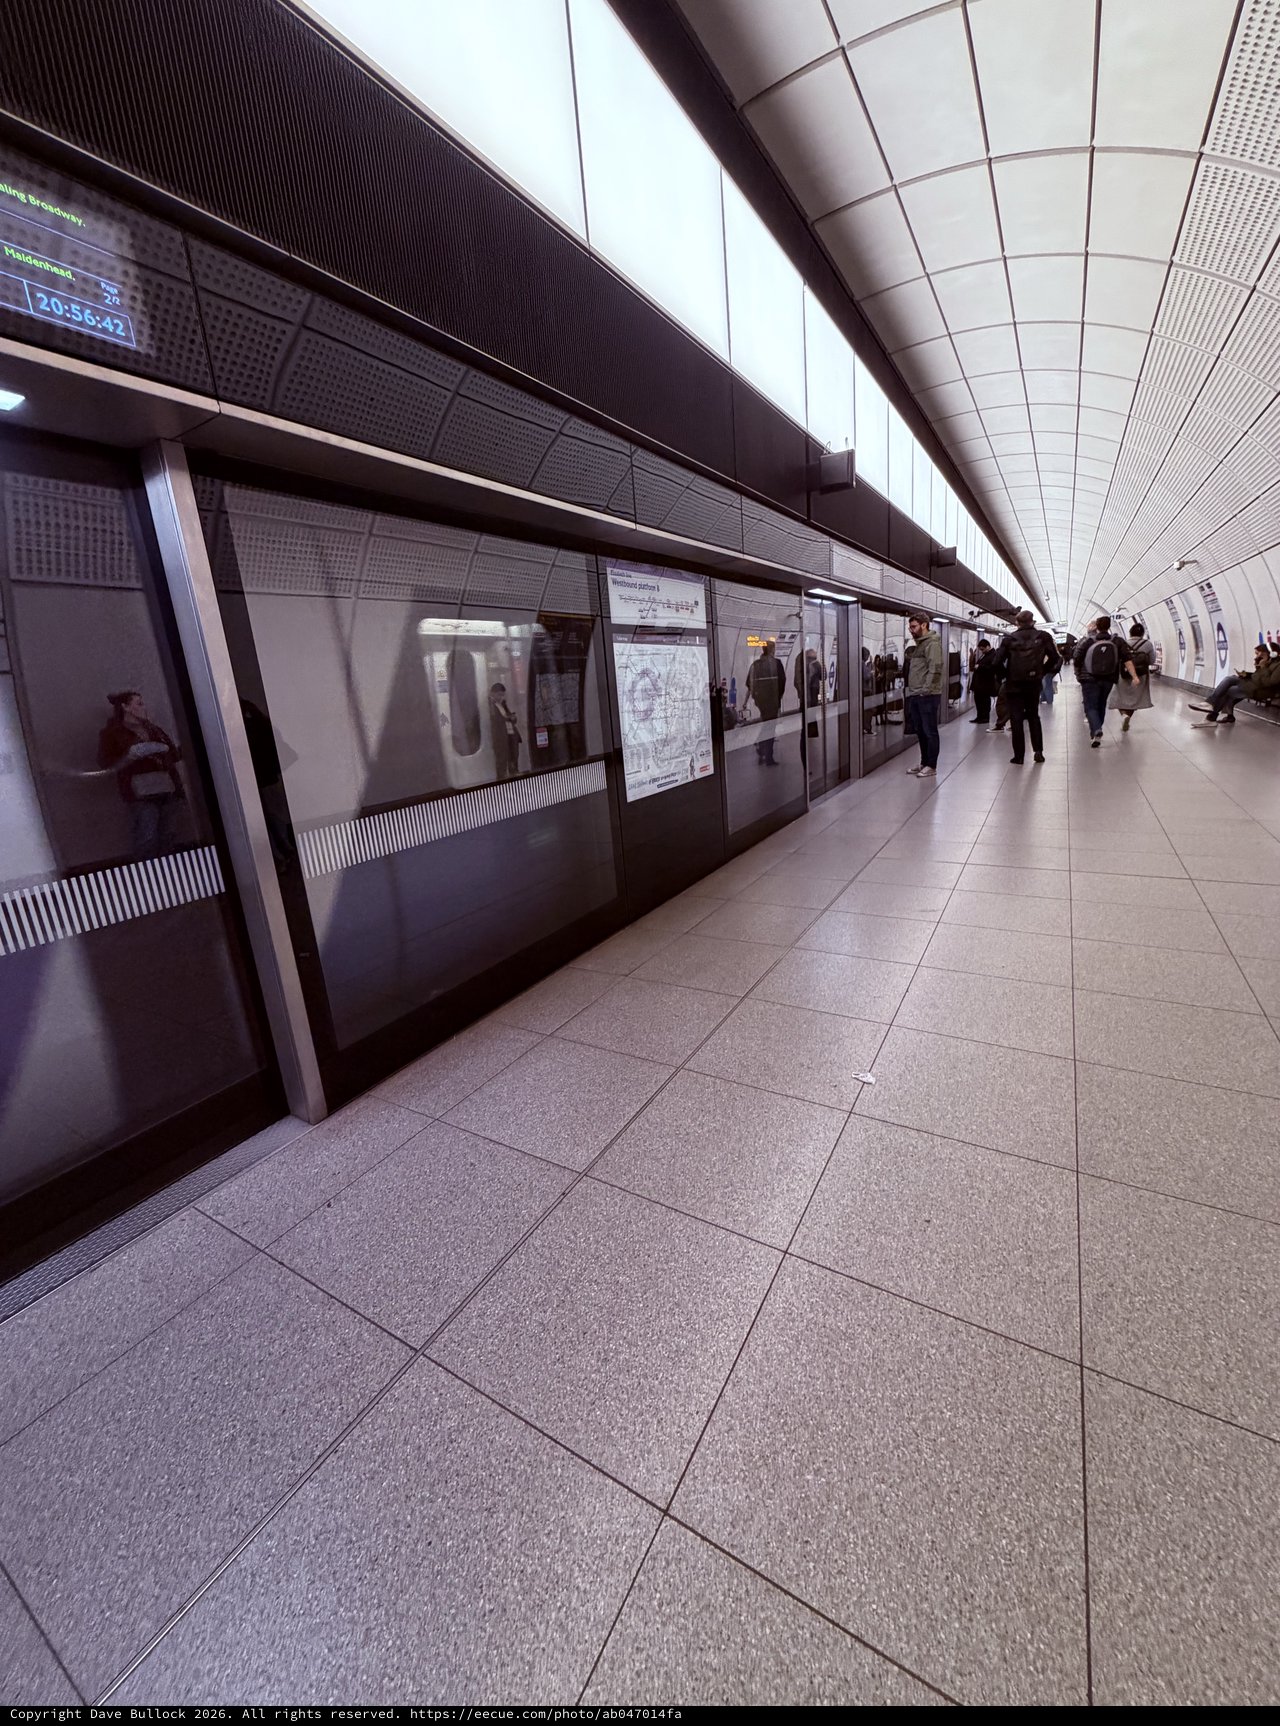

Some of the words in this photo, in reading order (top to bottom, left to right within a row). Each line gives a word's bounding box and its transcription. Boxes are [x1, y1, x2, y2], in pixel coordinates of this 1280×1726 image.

[28, 193, 86, 228] Broadway.
[4, 246, 76, 281] Maidenhead.
[36, 292, 125, 336] 20:56:42
[612, 579, 637, 590] Westbound
[638, 581, 656, 592] platform
